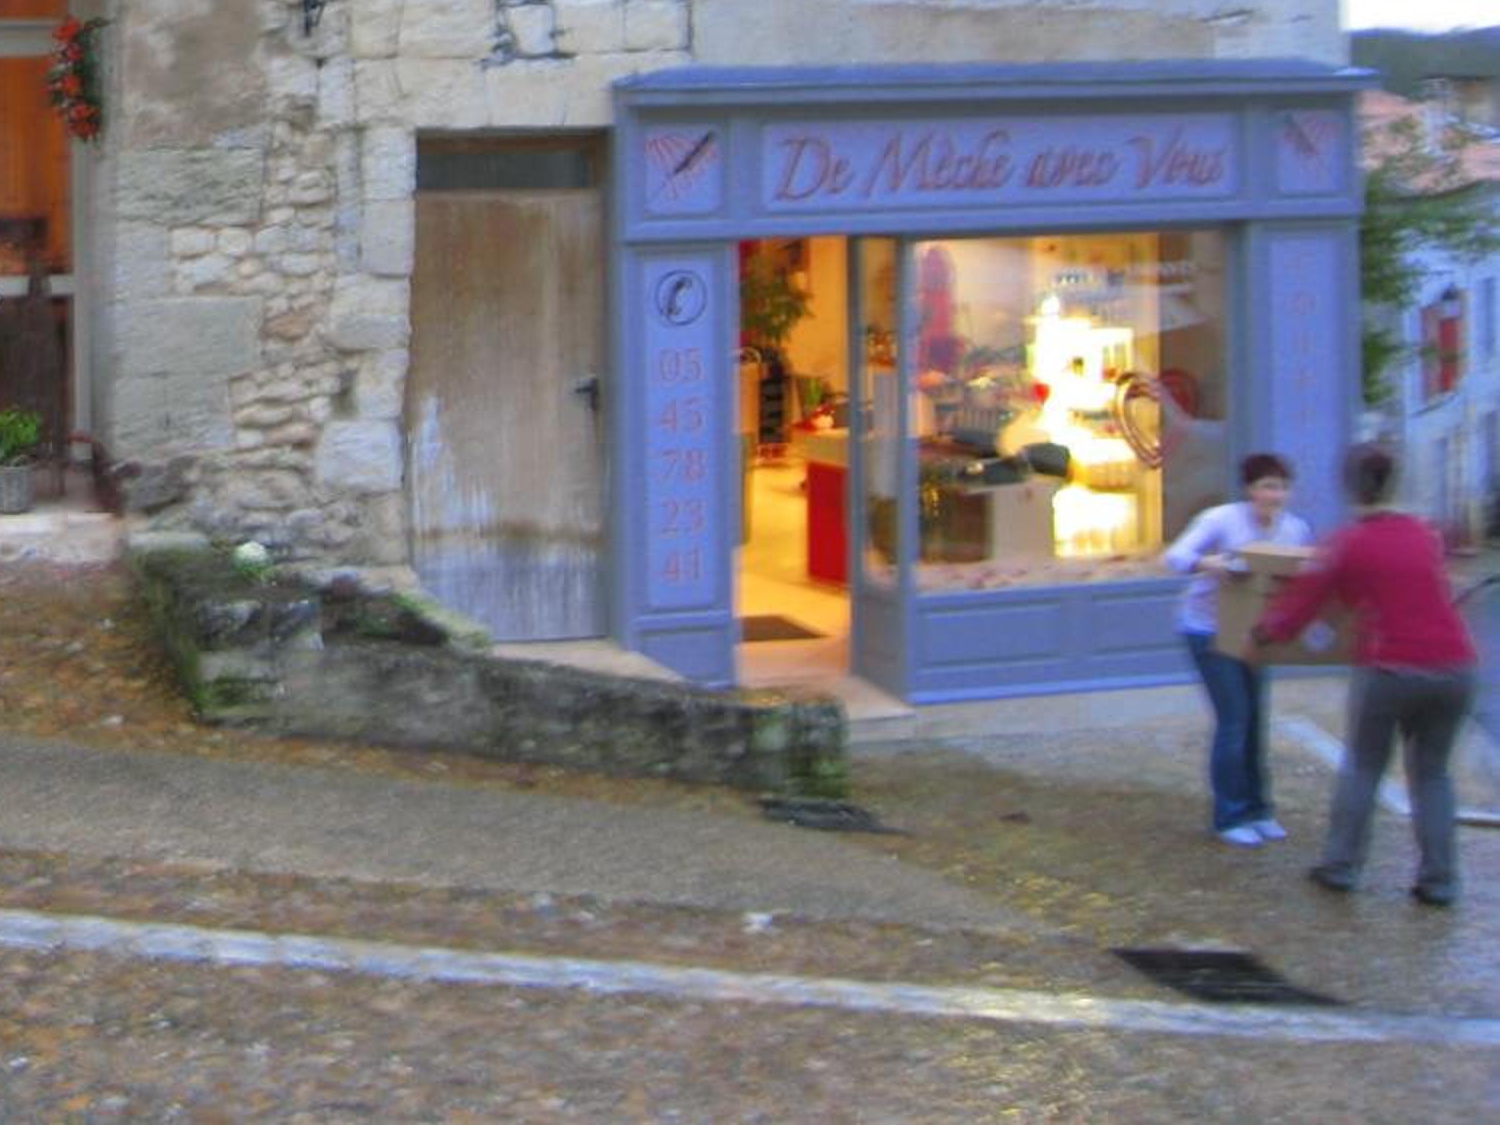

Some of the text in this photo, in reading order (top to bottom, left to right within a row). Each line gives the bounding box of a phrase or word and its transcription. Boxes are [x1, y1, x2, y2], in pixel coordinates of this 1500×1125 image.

[773, 134, 851, 201] De
[656, 348, 705, 384] 05
[657, 398, 704, 432] 45
[656, 449, 706, 484] 78
[662, 548, 705, 584] 41
